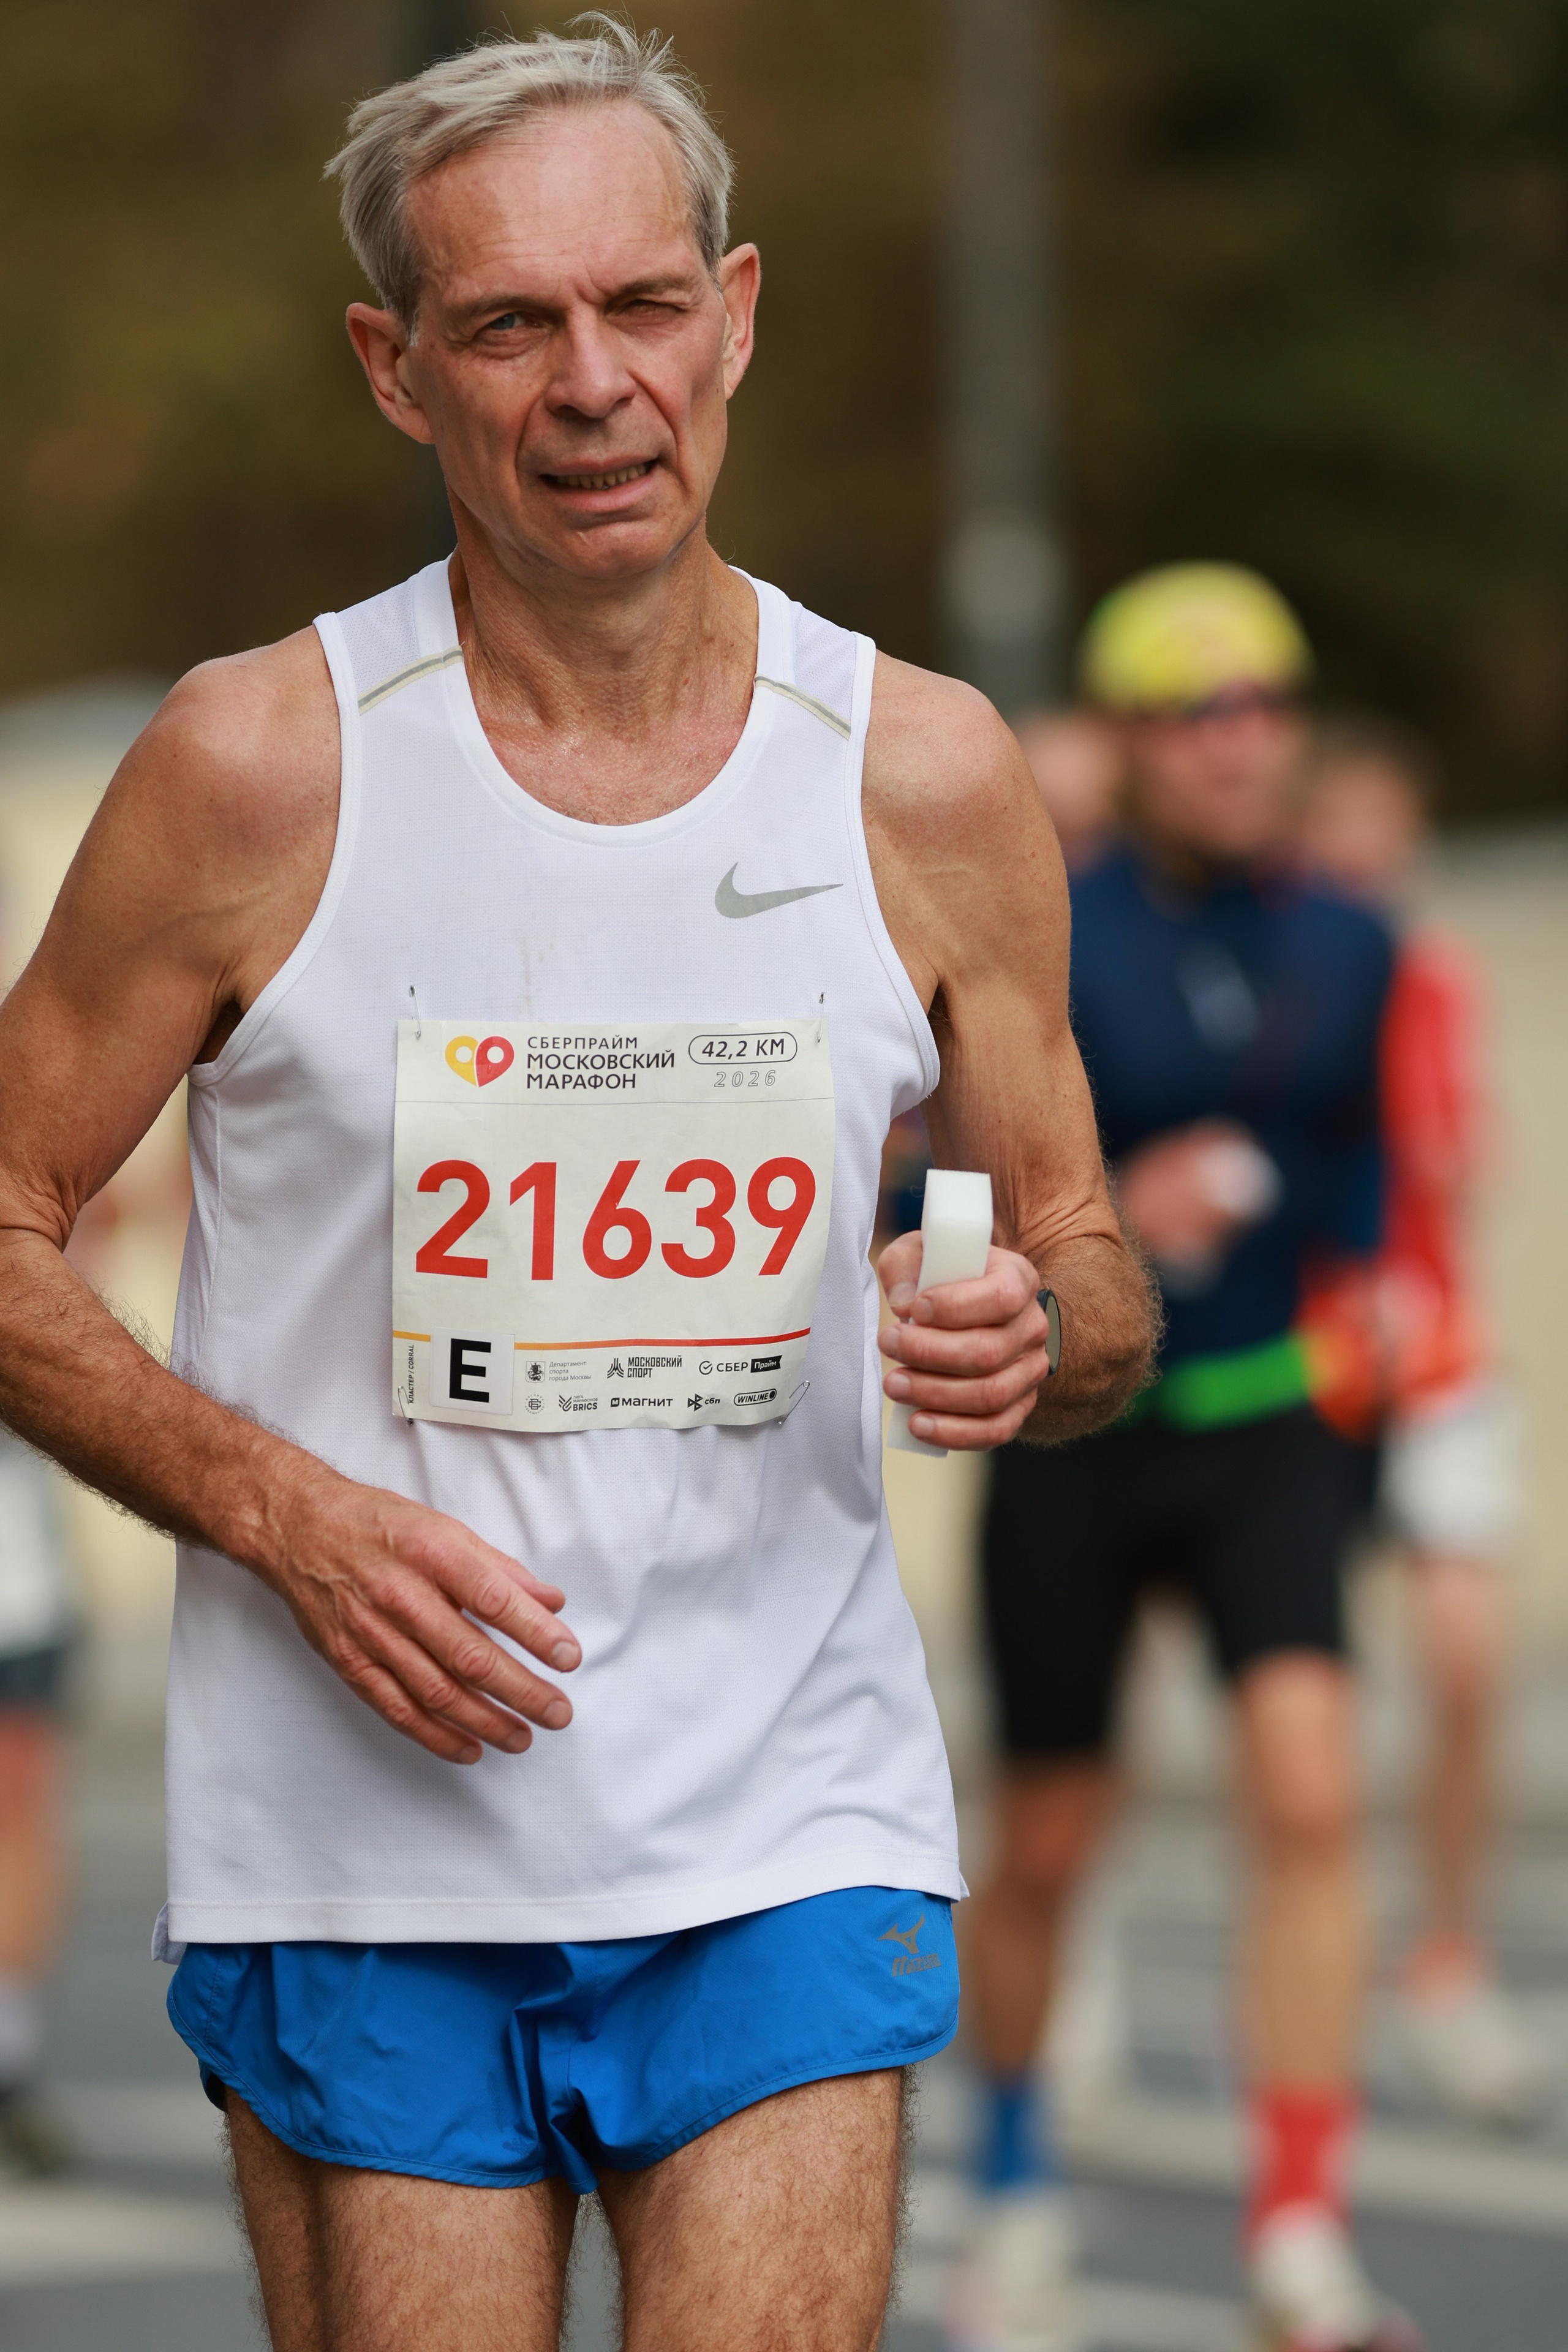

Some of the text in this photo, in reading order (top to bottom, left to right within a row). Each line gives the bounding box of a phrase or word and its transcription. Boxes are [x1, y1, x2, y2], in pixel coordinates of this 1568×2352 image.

[527, 1035, 638, 1049] СБЕРПРАЙМ
[701, 1038, 785, 1060] 42,2 КМ
[527, 1049, 676, 1069] МОСКОВСКИЙ
[526, 1074, 636, 1090] МАРАФОН
[714, 1069, 776, 1088] 2026
[415, 1156, 816, 1281] 21639
[628, 1355, 682, 1368] МОСКОВСКИЙ
[716, 1359, 777, 1373] СБЕР Прайм
[627, 1368, 653, 1378] СПОРТ
[737, 1392, 769, 1403] WINLINE
[573, 1403, 598, 1411] BRICS
[892, 1953, 941, 1977] MIZUNO
